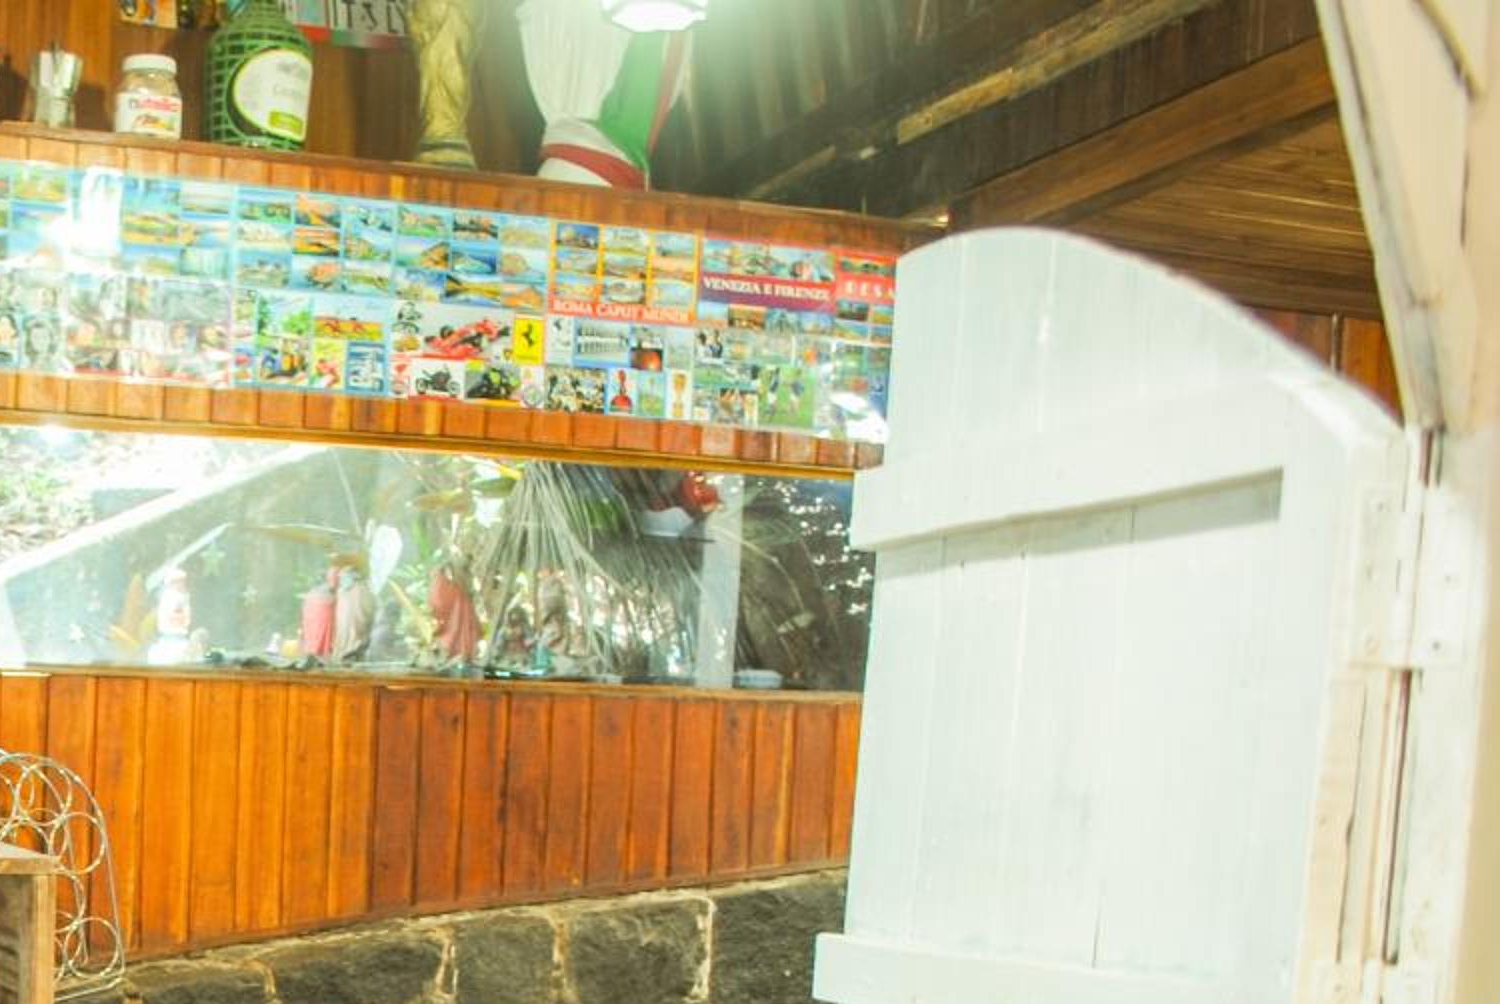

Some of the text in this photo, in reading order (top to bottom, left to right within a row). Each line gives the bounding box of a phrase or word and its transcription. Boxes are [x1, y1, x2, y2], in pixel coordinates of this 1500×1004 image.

[703, 276, 831, 301] VENEZIA E FIRENZE
[553, 299, 593, 314] ROMA
[595, 303, 640, 318] CAPUT
